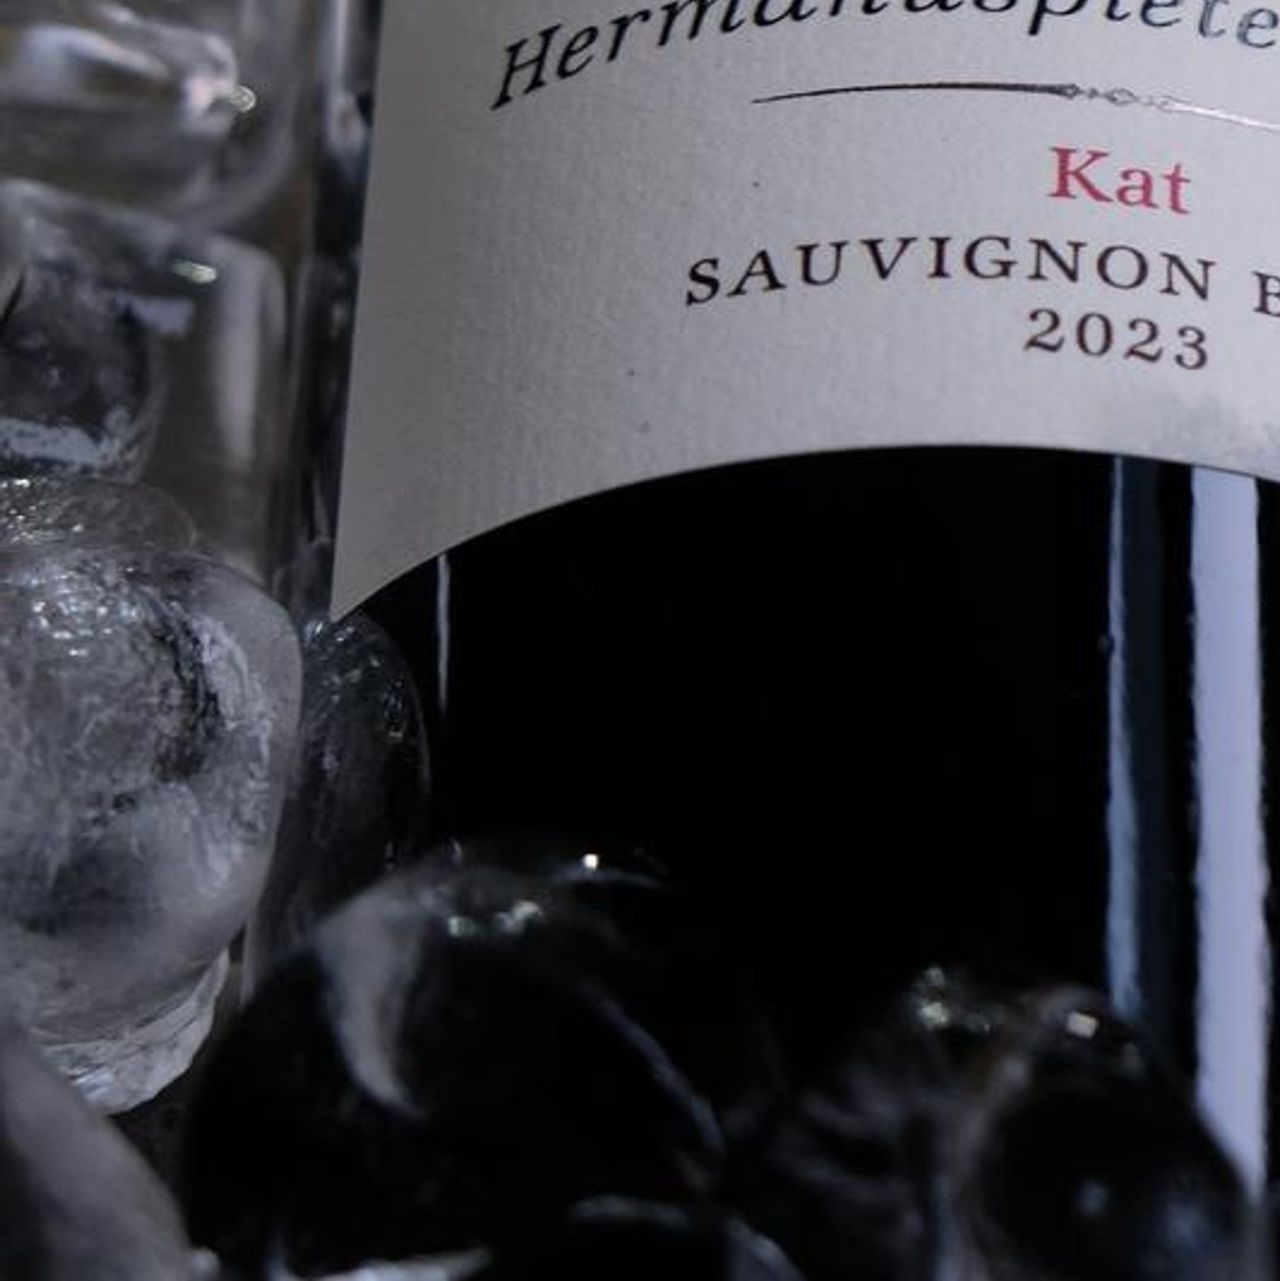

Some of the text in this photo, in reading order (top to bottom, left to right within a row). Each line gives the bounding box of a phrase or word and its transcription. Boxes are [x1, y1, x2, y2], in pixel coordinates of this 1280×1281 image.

[1047, 145, 1193, 216] Kat
[685, 234, 1217, 307] SAUVIGNON
[1022, 306, 1211, 372] 2023
